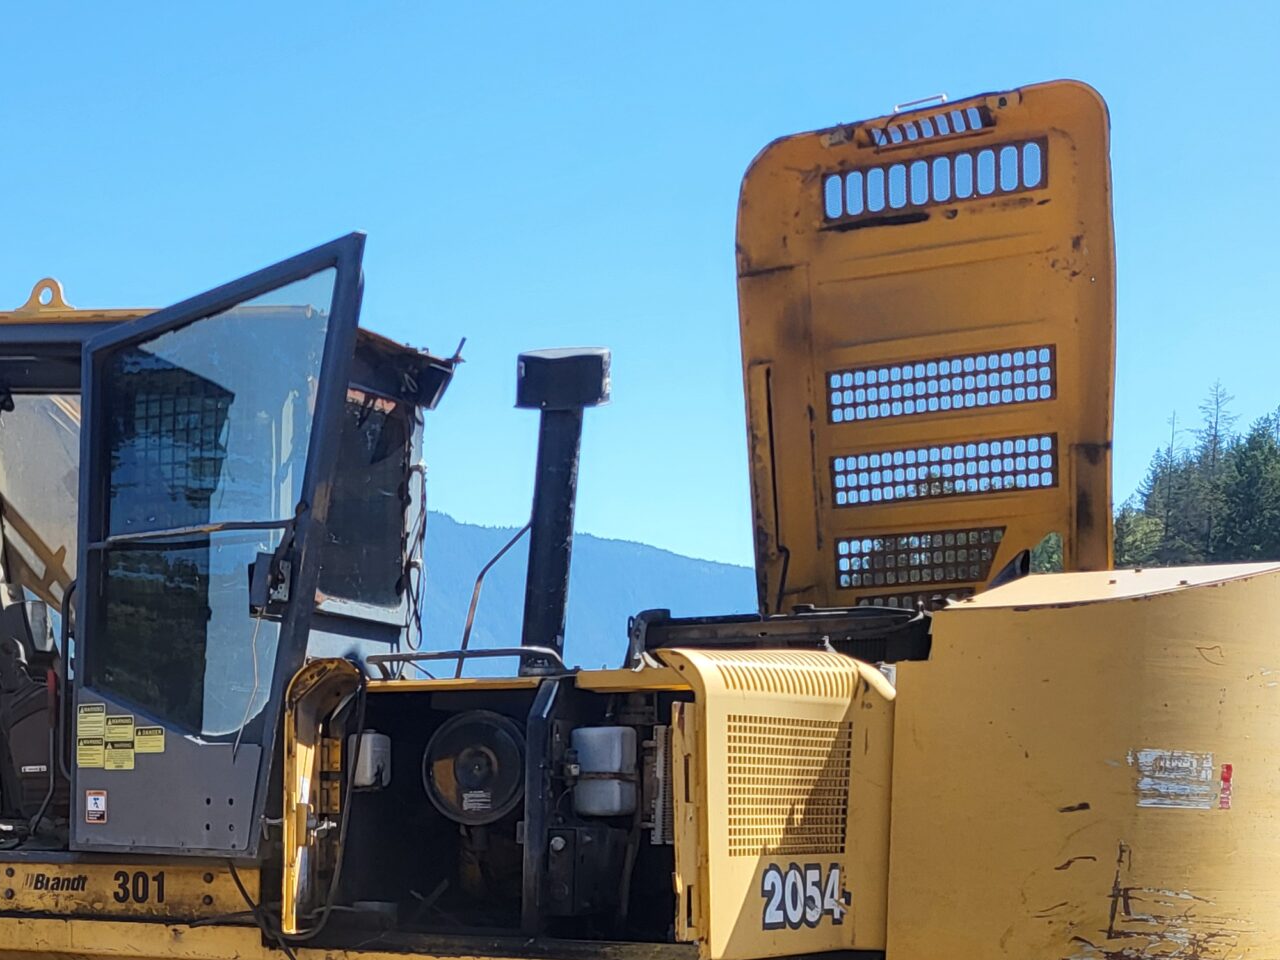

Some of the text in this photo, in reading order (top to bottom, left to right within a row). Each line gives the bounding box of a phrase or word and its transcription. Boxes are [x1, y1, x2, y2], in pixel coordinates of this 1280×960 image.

[34, 873, 88, 891] Brandt
[113, 871, 165, 904] 301
[762, 865, 850, 928] 2054
